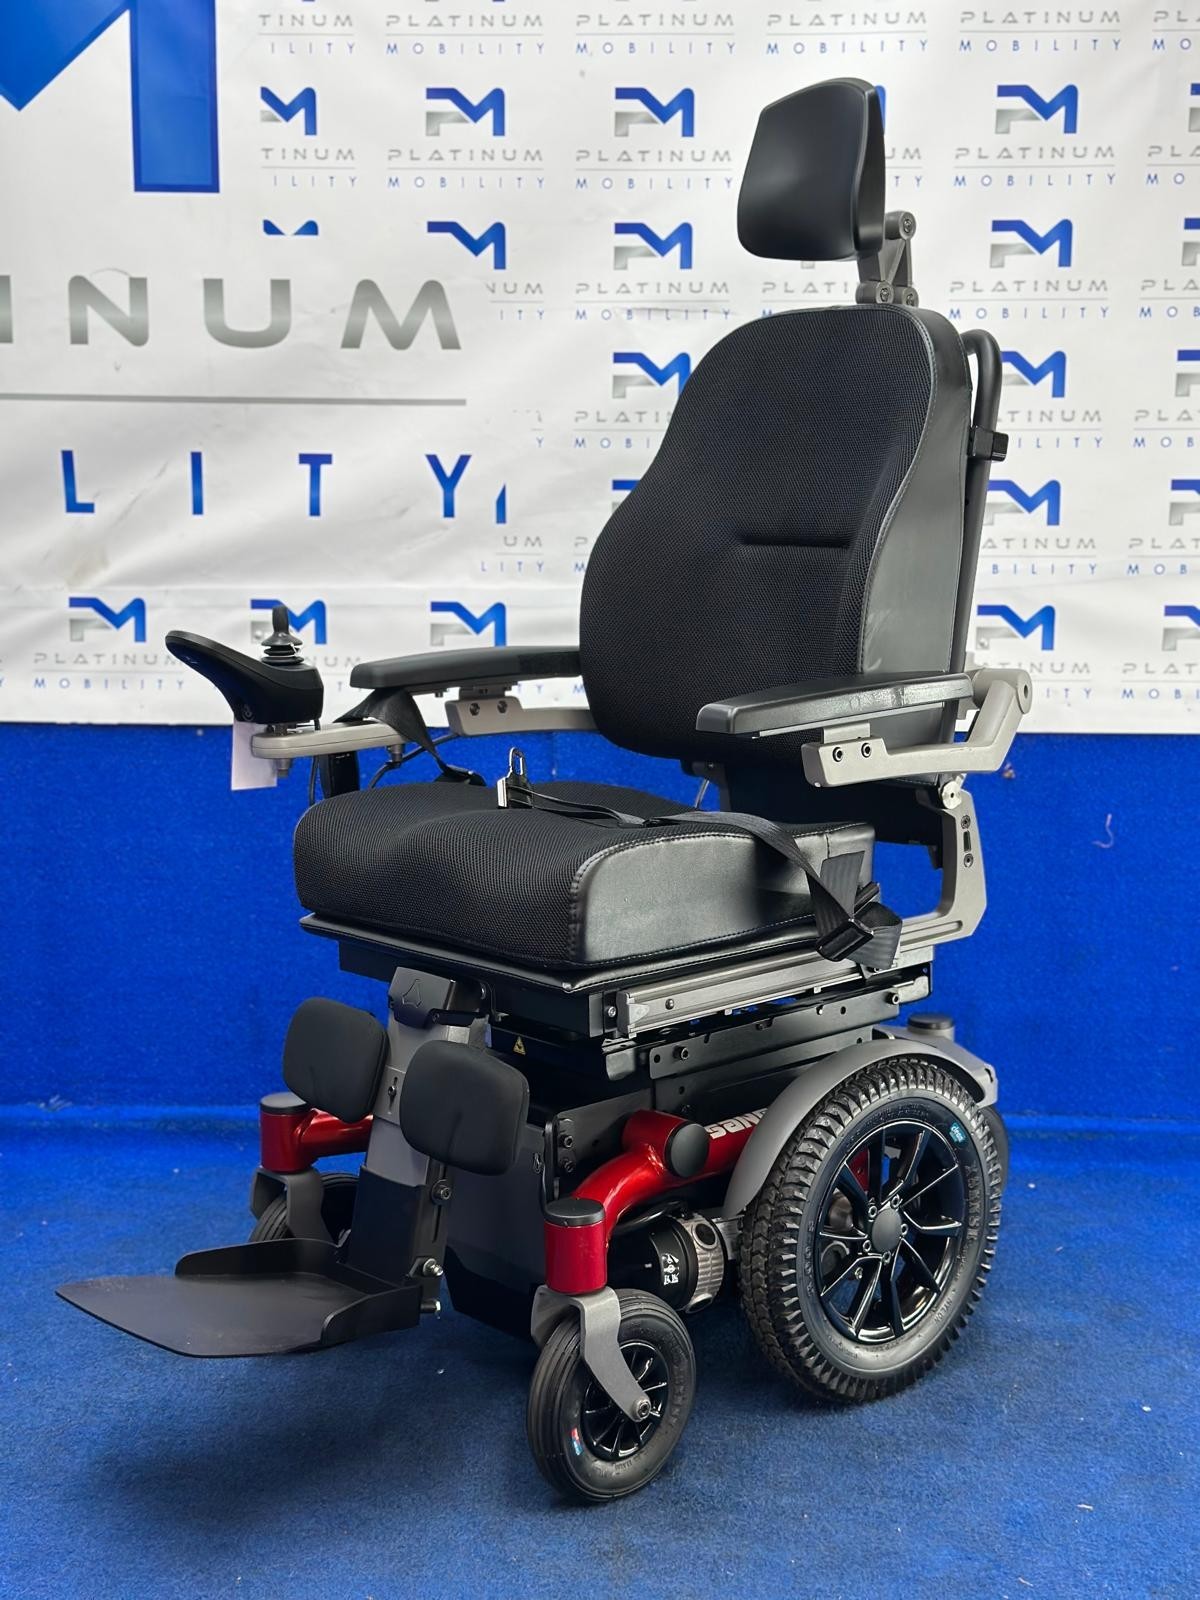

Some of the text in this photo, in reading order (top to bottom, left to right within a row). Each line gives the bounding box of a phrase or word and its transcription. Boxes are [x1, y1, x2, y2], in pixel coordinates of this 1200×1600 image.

[386, 15, 542, 27] PLATINUM
[576, 14, 734, 27] PLATINUM
[767, 12, 927, 26] PLATINUM
[960, 11, 1120, 24] PLATINUM
[386, 43, 543, 54] MOBILITY
[576, 42, 735, 54] MOBILITY
[766, 40, 927, 54] MOBILITY
[959, 39, 1121, 52] MOBILITY
[388, 149, 543, 162] PLATINUM
[576, 150, 732, 162] PLATINUM
[955, 146, 1115, 160] PLATINUM
[388, 177, 544, 188] MOBILITY
[576, 178, 732, 189] MOBILITY
[954, 174, 1115, 187] MOBILITY
[576, 281, 730, 295] PLATINUM
[950, 278, 1108, 293] PLATINUM
[575, 309, 731, 321] MOBILITY
[949, 306, 1109, 320] MOBILITY
[997, 409, 1101, 423] TINUM
[62, 450, 471, 518] LITY
[34, 677, 183, 689] MOBILITY
